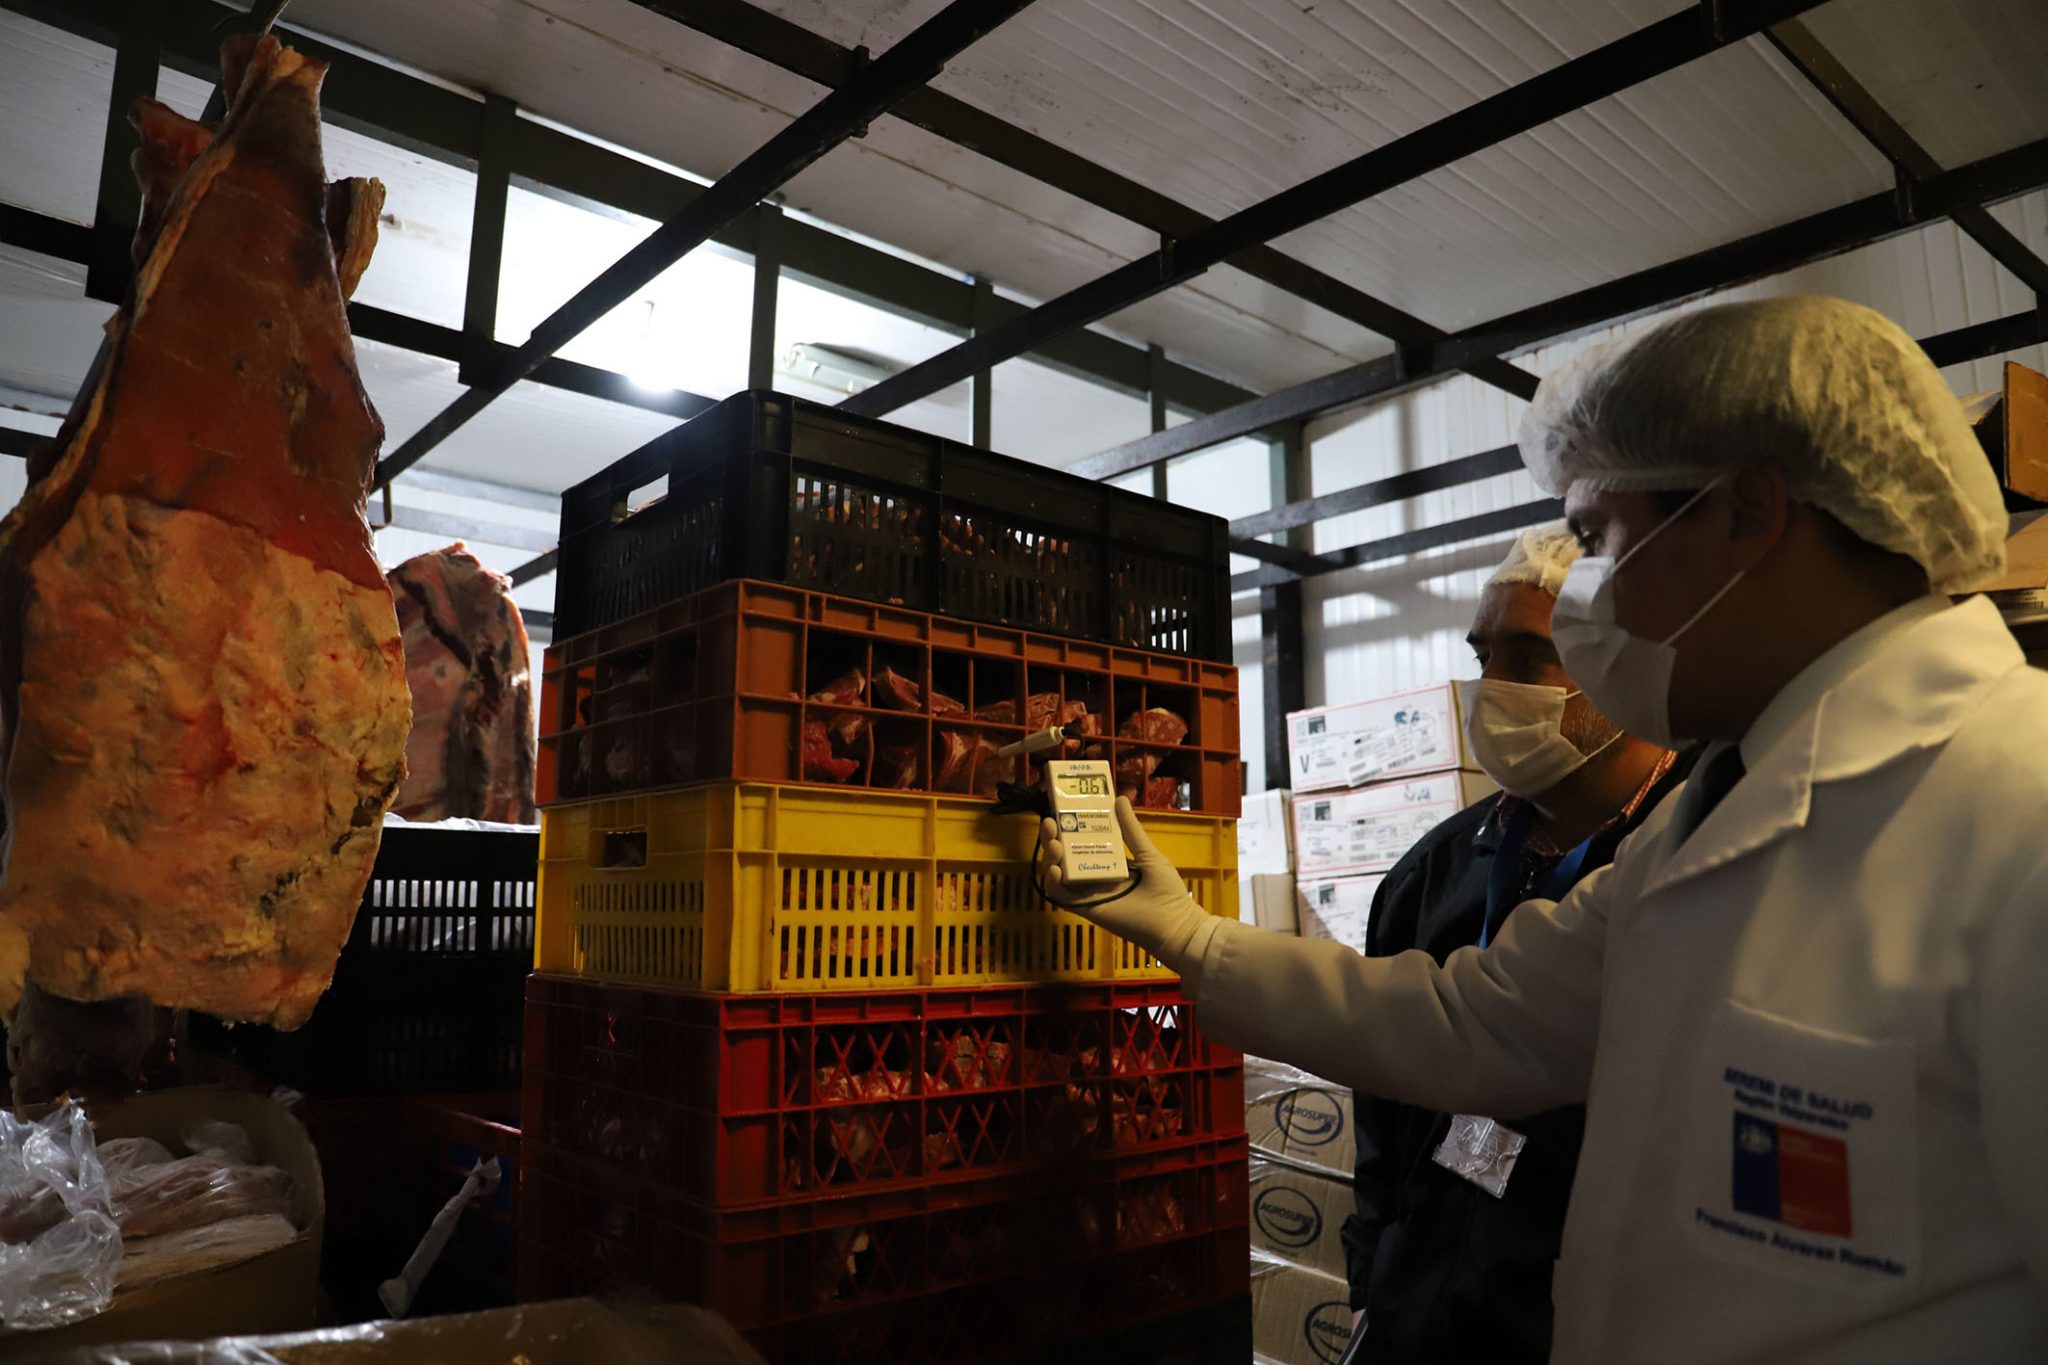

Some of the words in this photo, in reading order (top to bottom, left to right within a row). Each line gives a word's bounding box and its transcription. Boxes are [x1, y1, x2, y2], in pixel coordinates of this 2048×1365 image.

[1779, 1084, 1802, 1102] DE
[1808, 1092, 1873, 1120] SALUD
[1281, 1105, 1338, 1124] AGROSUPER
[1260, 1202, 1316, 1226] AGROSUPER
